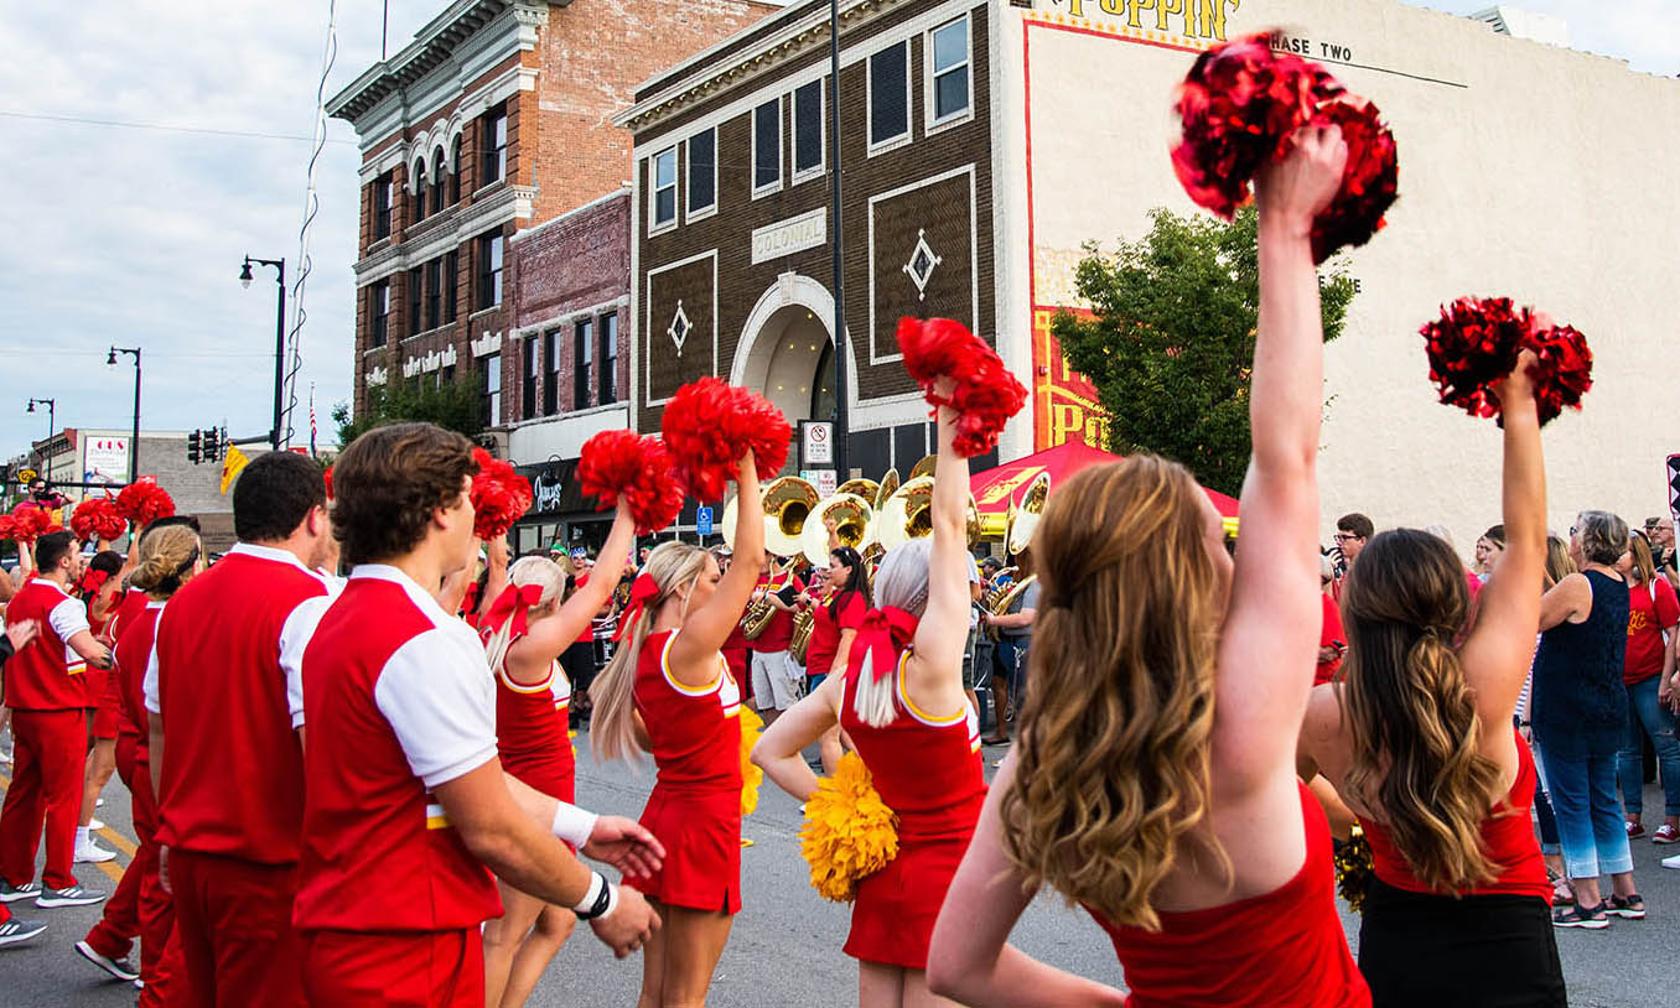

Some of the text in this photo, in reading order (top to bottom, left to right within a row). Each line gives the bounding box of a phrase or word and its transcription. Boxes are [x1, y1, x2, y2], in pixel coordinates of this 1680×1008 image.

[1271, 35, 1352, 61] HASE TWO
[755, 218, 823, 255] COLONIAL
